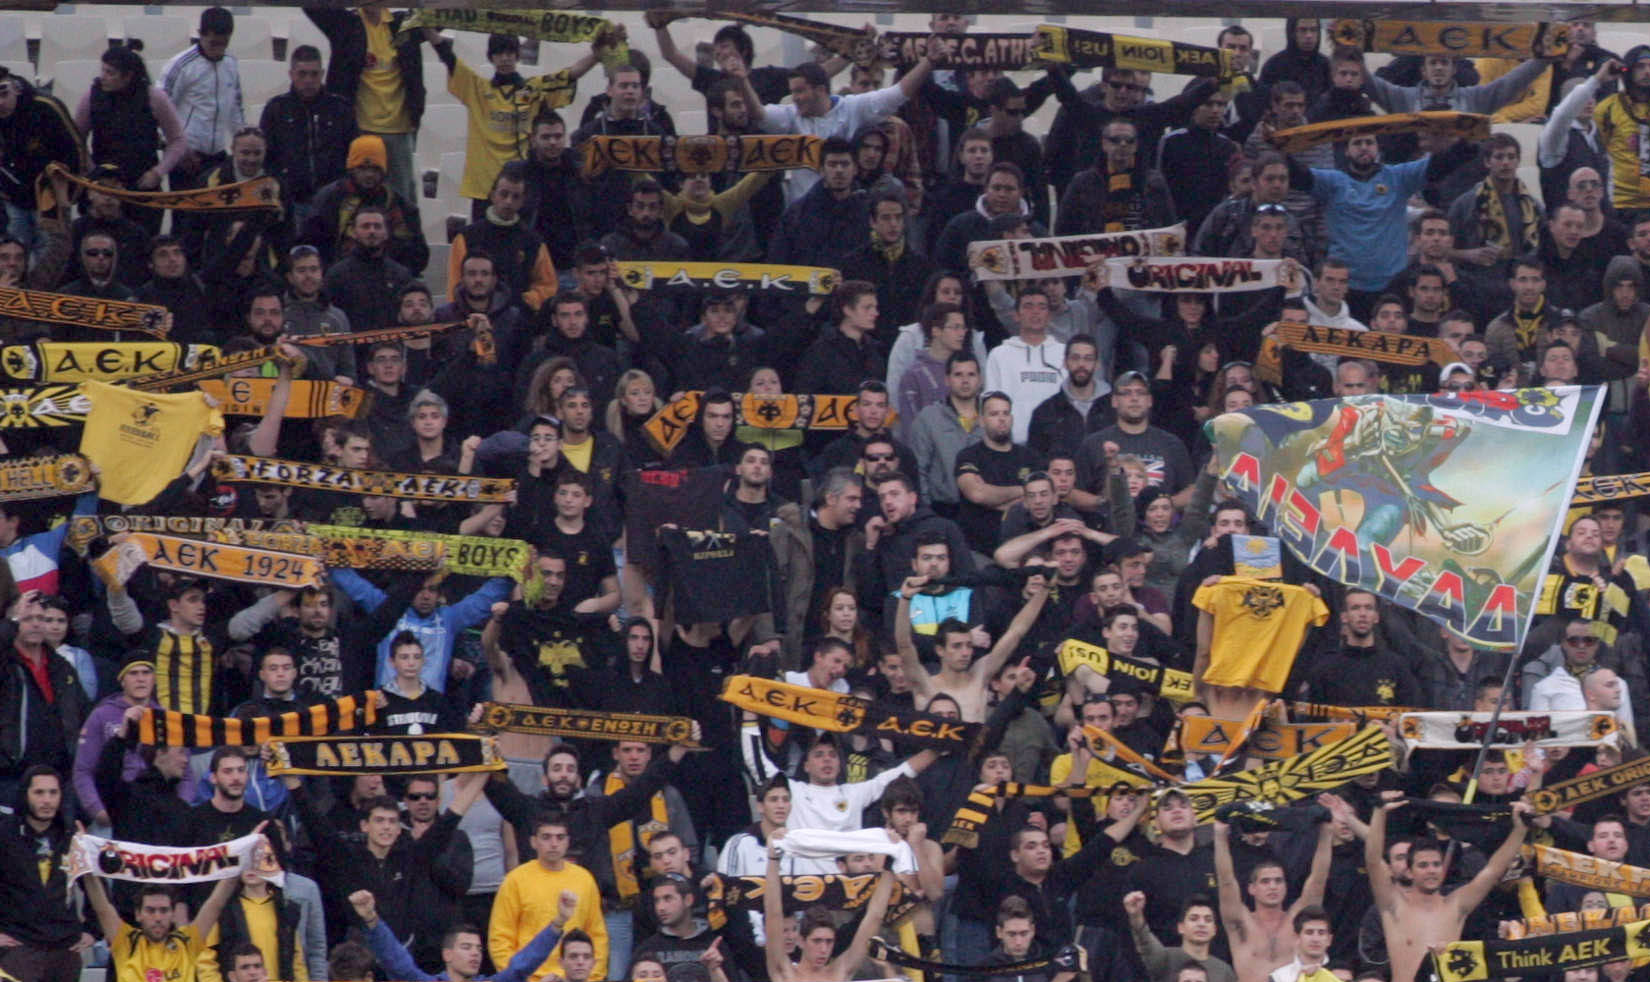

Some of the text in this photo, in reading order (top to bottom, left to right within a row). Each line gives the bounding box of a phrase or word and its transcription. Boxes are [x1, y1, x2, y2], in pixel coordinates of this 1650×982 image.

[54, 349, 166, 374] A.E.K
[32, 396, 93, 416] AE
[253, 462, 353, 488] FORZA
[152, 537, 216, 569] AEK
[242, 554, 305, 580] 1924
[458, 543, 519, 569] BOYS
[1113, 660, 1158, 683] JOIN
[1168, 675, 1193, 693] EK
[315, 740, 460, 767] ΑΕΚΑΡΑ
[1496, 937, 1612, 970] Think AEK
